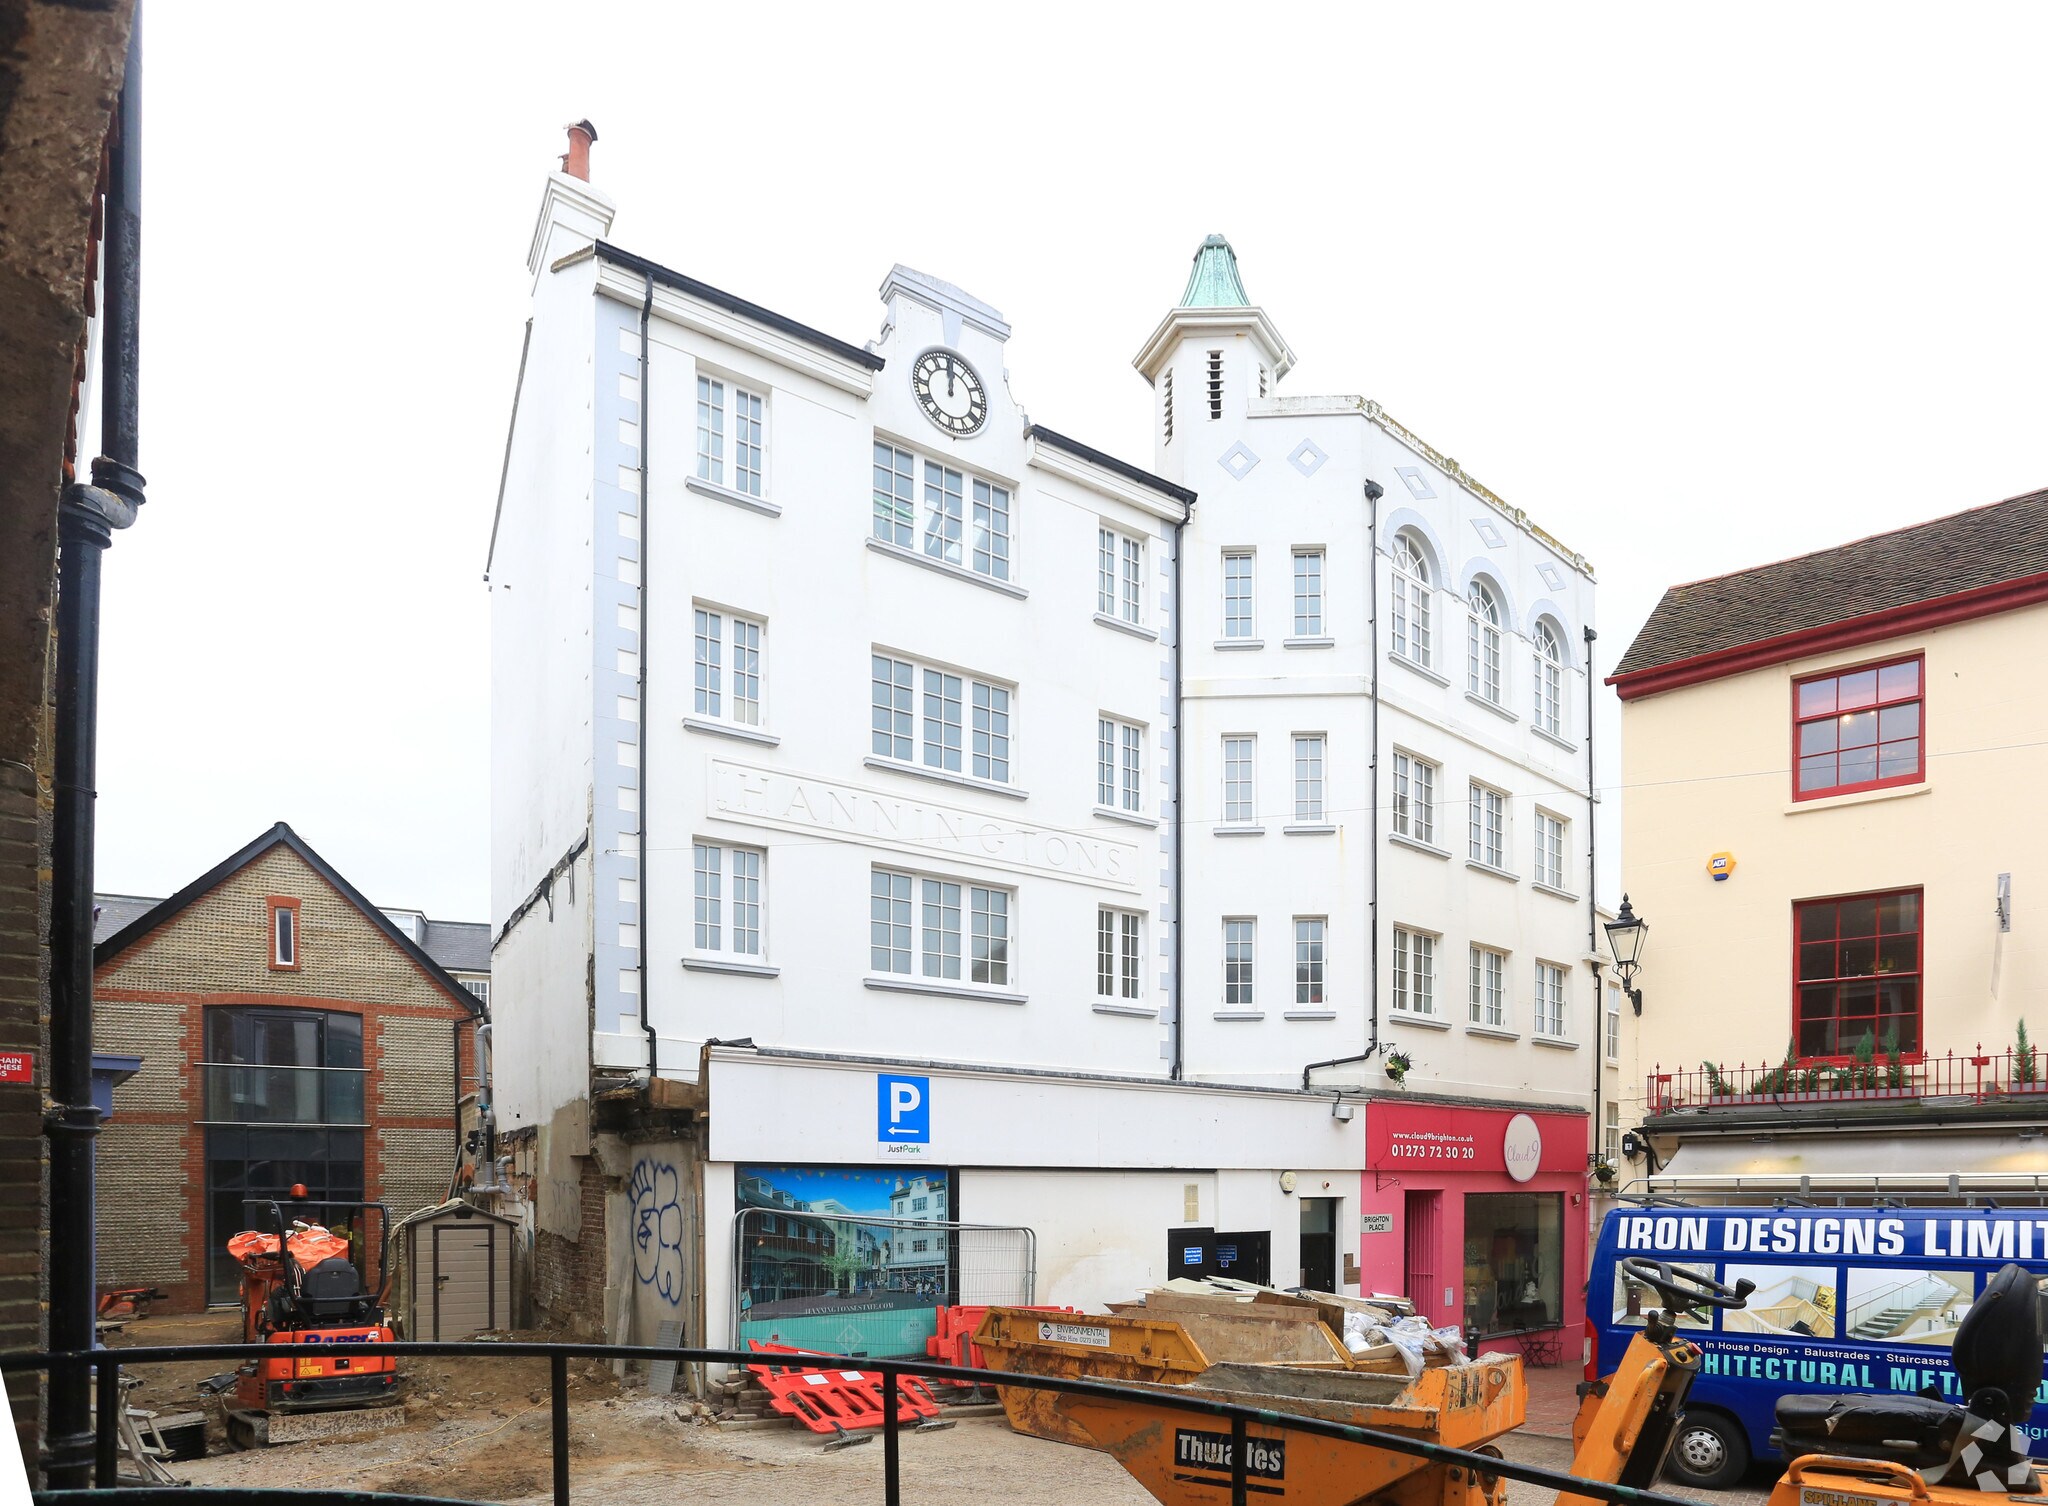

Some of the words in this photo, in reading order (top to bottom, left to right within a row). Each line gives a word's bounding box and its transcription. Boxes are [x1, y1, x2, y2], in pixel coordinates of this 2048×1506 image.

[738, 773, 1120, 876] HANNINGTONS
[1713, 859, 1726, 868] ADT
[890, 1082, 921, 1123] P
[1392, 1132, 1474, 1143] www.cloud9brighton.co.uk
[887, 1144, 921, 1154] JustPark
[1391, 1144, 1426, 1157] 01273
[1429, 1145, 1442, 1158] 72
[1445, 1146, 1459, 1159] 30
[1462, 1147, 1474, 1159] 20
[1507, 1144, 1530, 1162] Cloud
[1531, 1140, 1539, 1162] 9
[1364, 1215, 1390, 1223] BRIGHTON
[1368, 1223, 1385, 1231] PLACE
[1617, 1217, 1709, 1250] IRON
[1723, 1218, 1905, 1255] DESIGNS
[1056, 1324, 1106, 1338] ENVIRONMENTAL
[1705, 1341, 1715, 1349] In
[1718, 1341, 1750, 1352] House
[1753, 1343, 1789, 1355] Design
[1804, 1348, 1870, 1361] Balustrades
[1886, 1353, 1950, 1367] Staircases
[1698, 1352, 1875, 1389] HITECTURAL
[1178, 1434, 1281, 1472] Thwates
